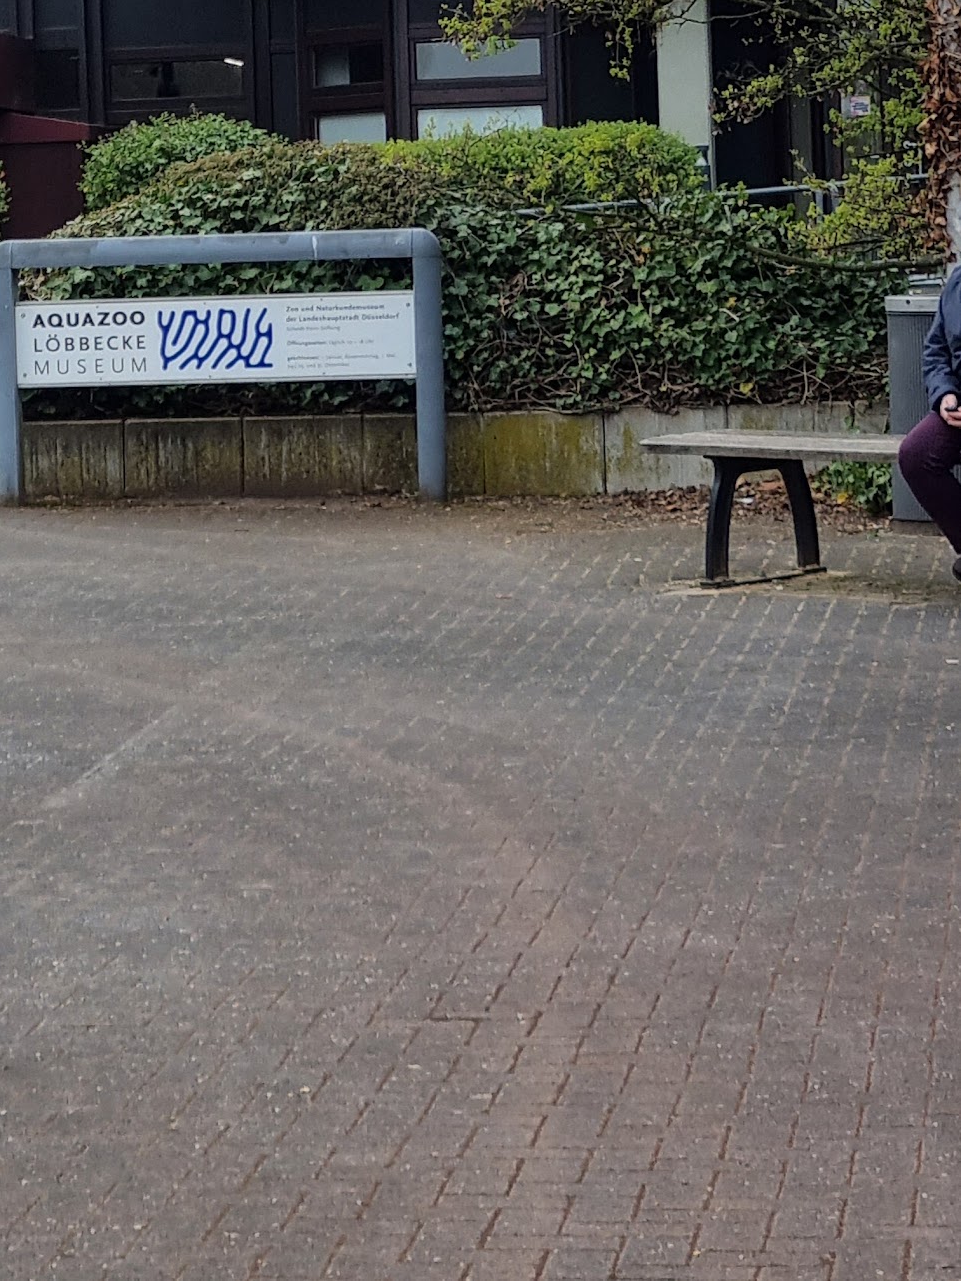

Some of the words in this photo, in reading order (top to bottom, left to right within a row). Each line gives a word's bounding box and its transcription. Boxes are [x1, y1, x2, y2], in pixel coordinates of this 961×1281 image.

[32, 310, 146, 329] AQUAZOO
[299, 314, 360, 323] Landeshauptstadt
[361, 312, 400, 321] Düsseldorf
[34, 335, 146, 353] LÖBBECKE
[34, 357, 147, 376] MUSEUM
